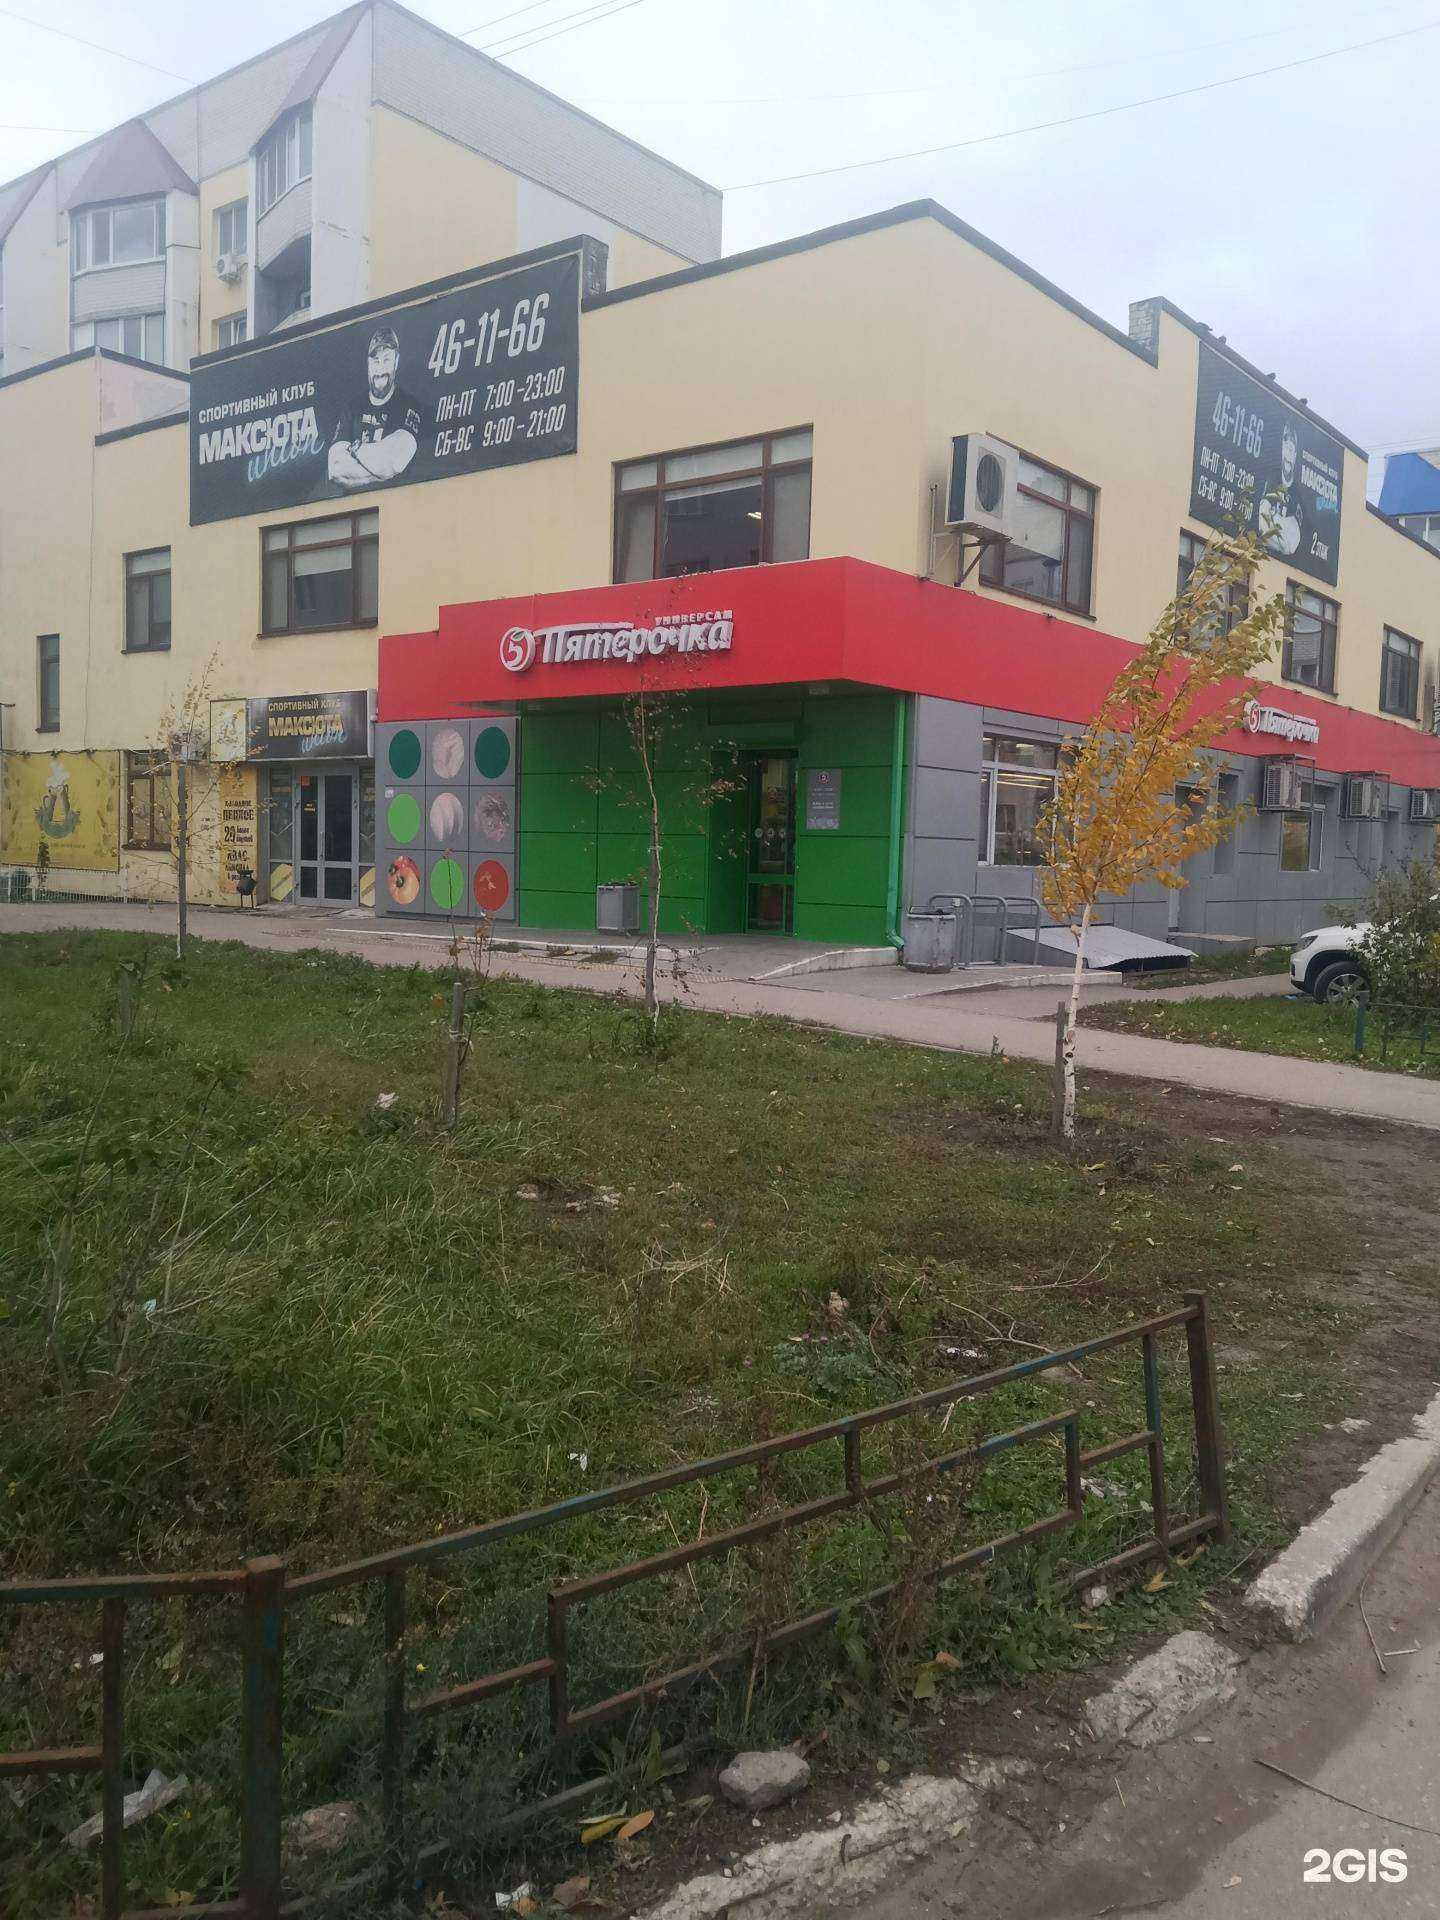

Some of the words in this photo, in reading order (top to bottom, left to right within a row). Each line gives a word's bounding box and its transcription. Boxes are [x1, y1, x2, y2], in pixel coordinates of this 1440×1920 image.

[428, 293, 550, 377] 46-11-66
[199, 388, 278, 423] СПОРТИВНЫЙ
[282, 381, 315, 403] КЛУБ
[436, 389, 477, 422] ПН-ПТ
[199, 406, 318, 465] МАКСЮТА
[434, 425, 475, 457] СБ-ВС
[1213, 392, 1264, 458] 46-11-66
[655, 609, 733, 627] УНИВЕРСАМ
[533, 621, 735, 664] Пятерочка
[268, 698, 319, 711] СПОРТИВНЫЙ
[268, 714, 345, 736] МАКСЮТА
